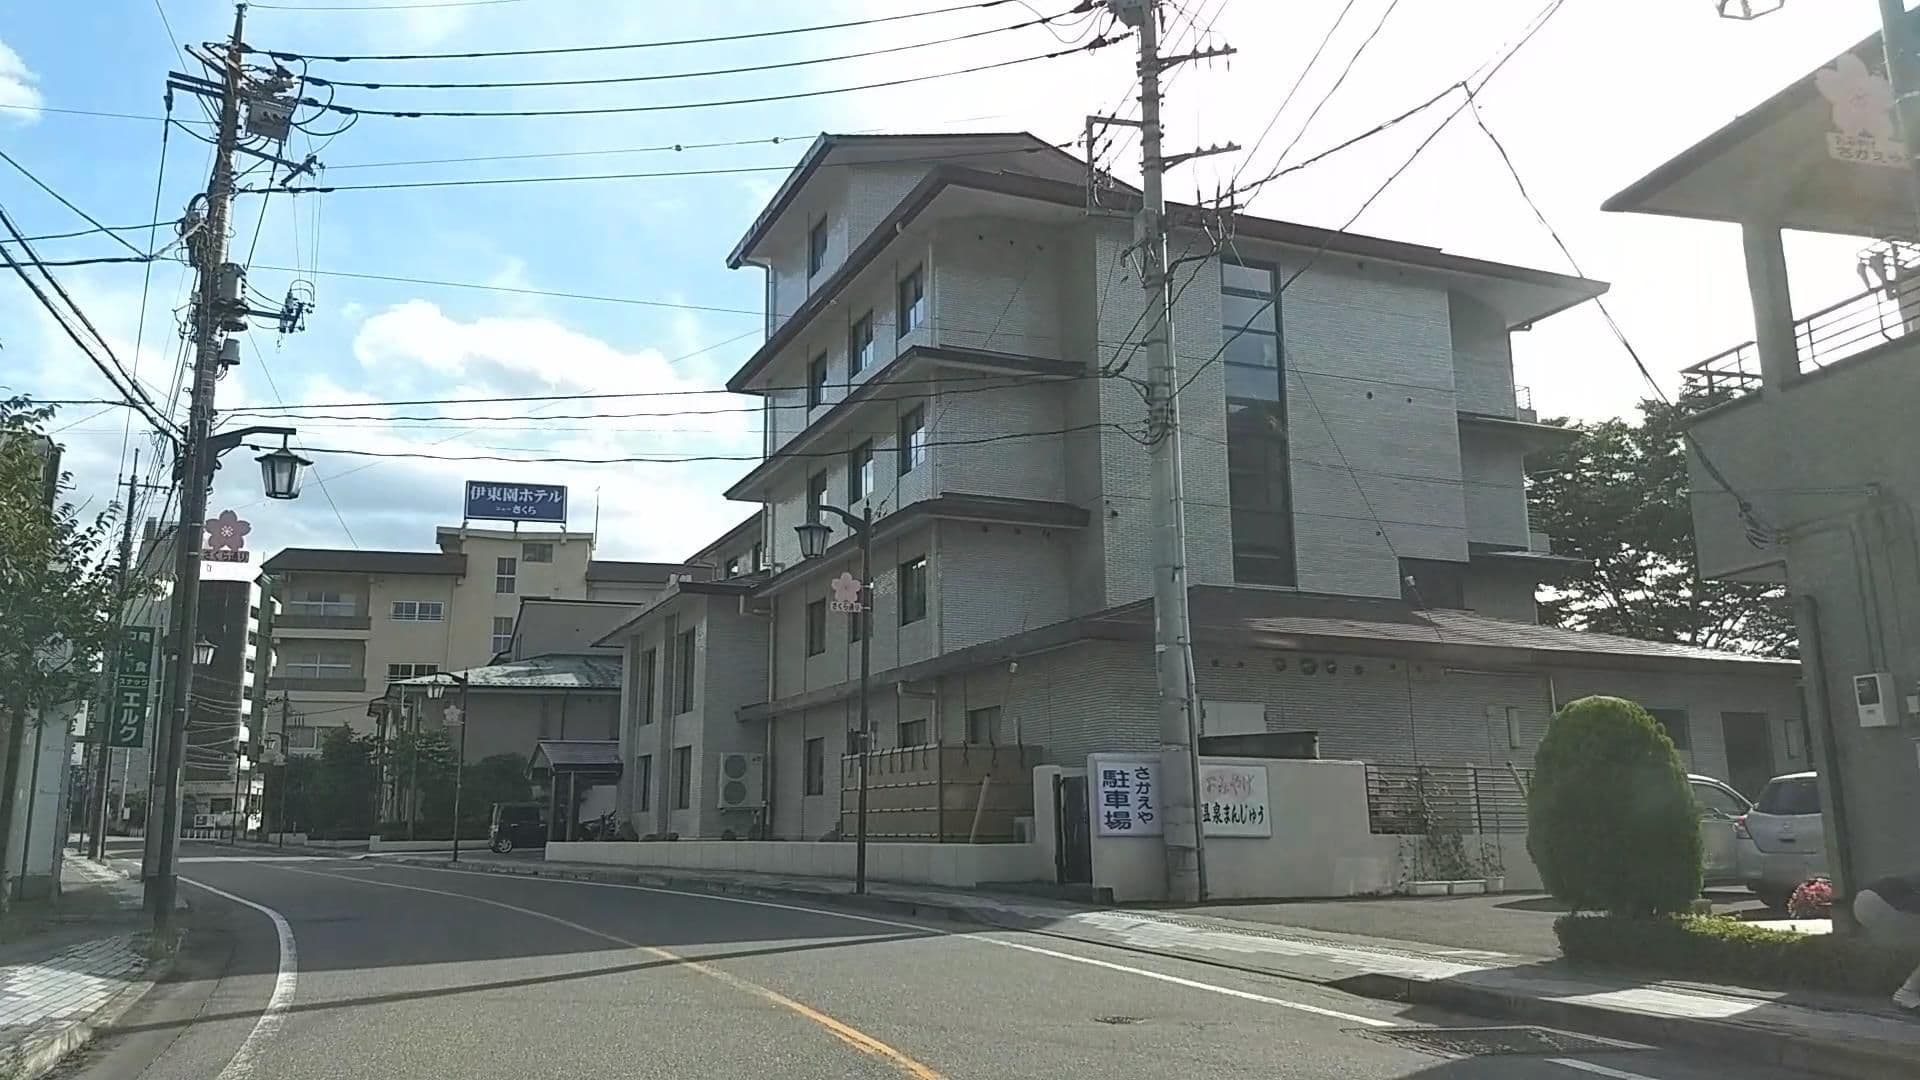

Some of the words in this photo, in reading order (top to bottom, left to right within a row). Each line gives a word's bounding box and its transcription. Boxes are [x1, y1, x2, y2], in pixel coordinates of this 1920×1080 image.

[471, 485, 563, 503] 伊東園ホテル
[120, 692, 140, 742] エルク
[1102, 770, 1132, 830] 駐車場
[1134, 766, 1154, 824] さかえや
